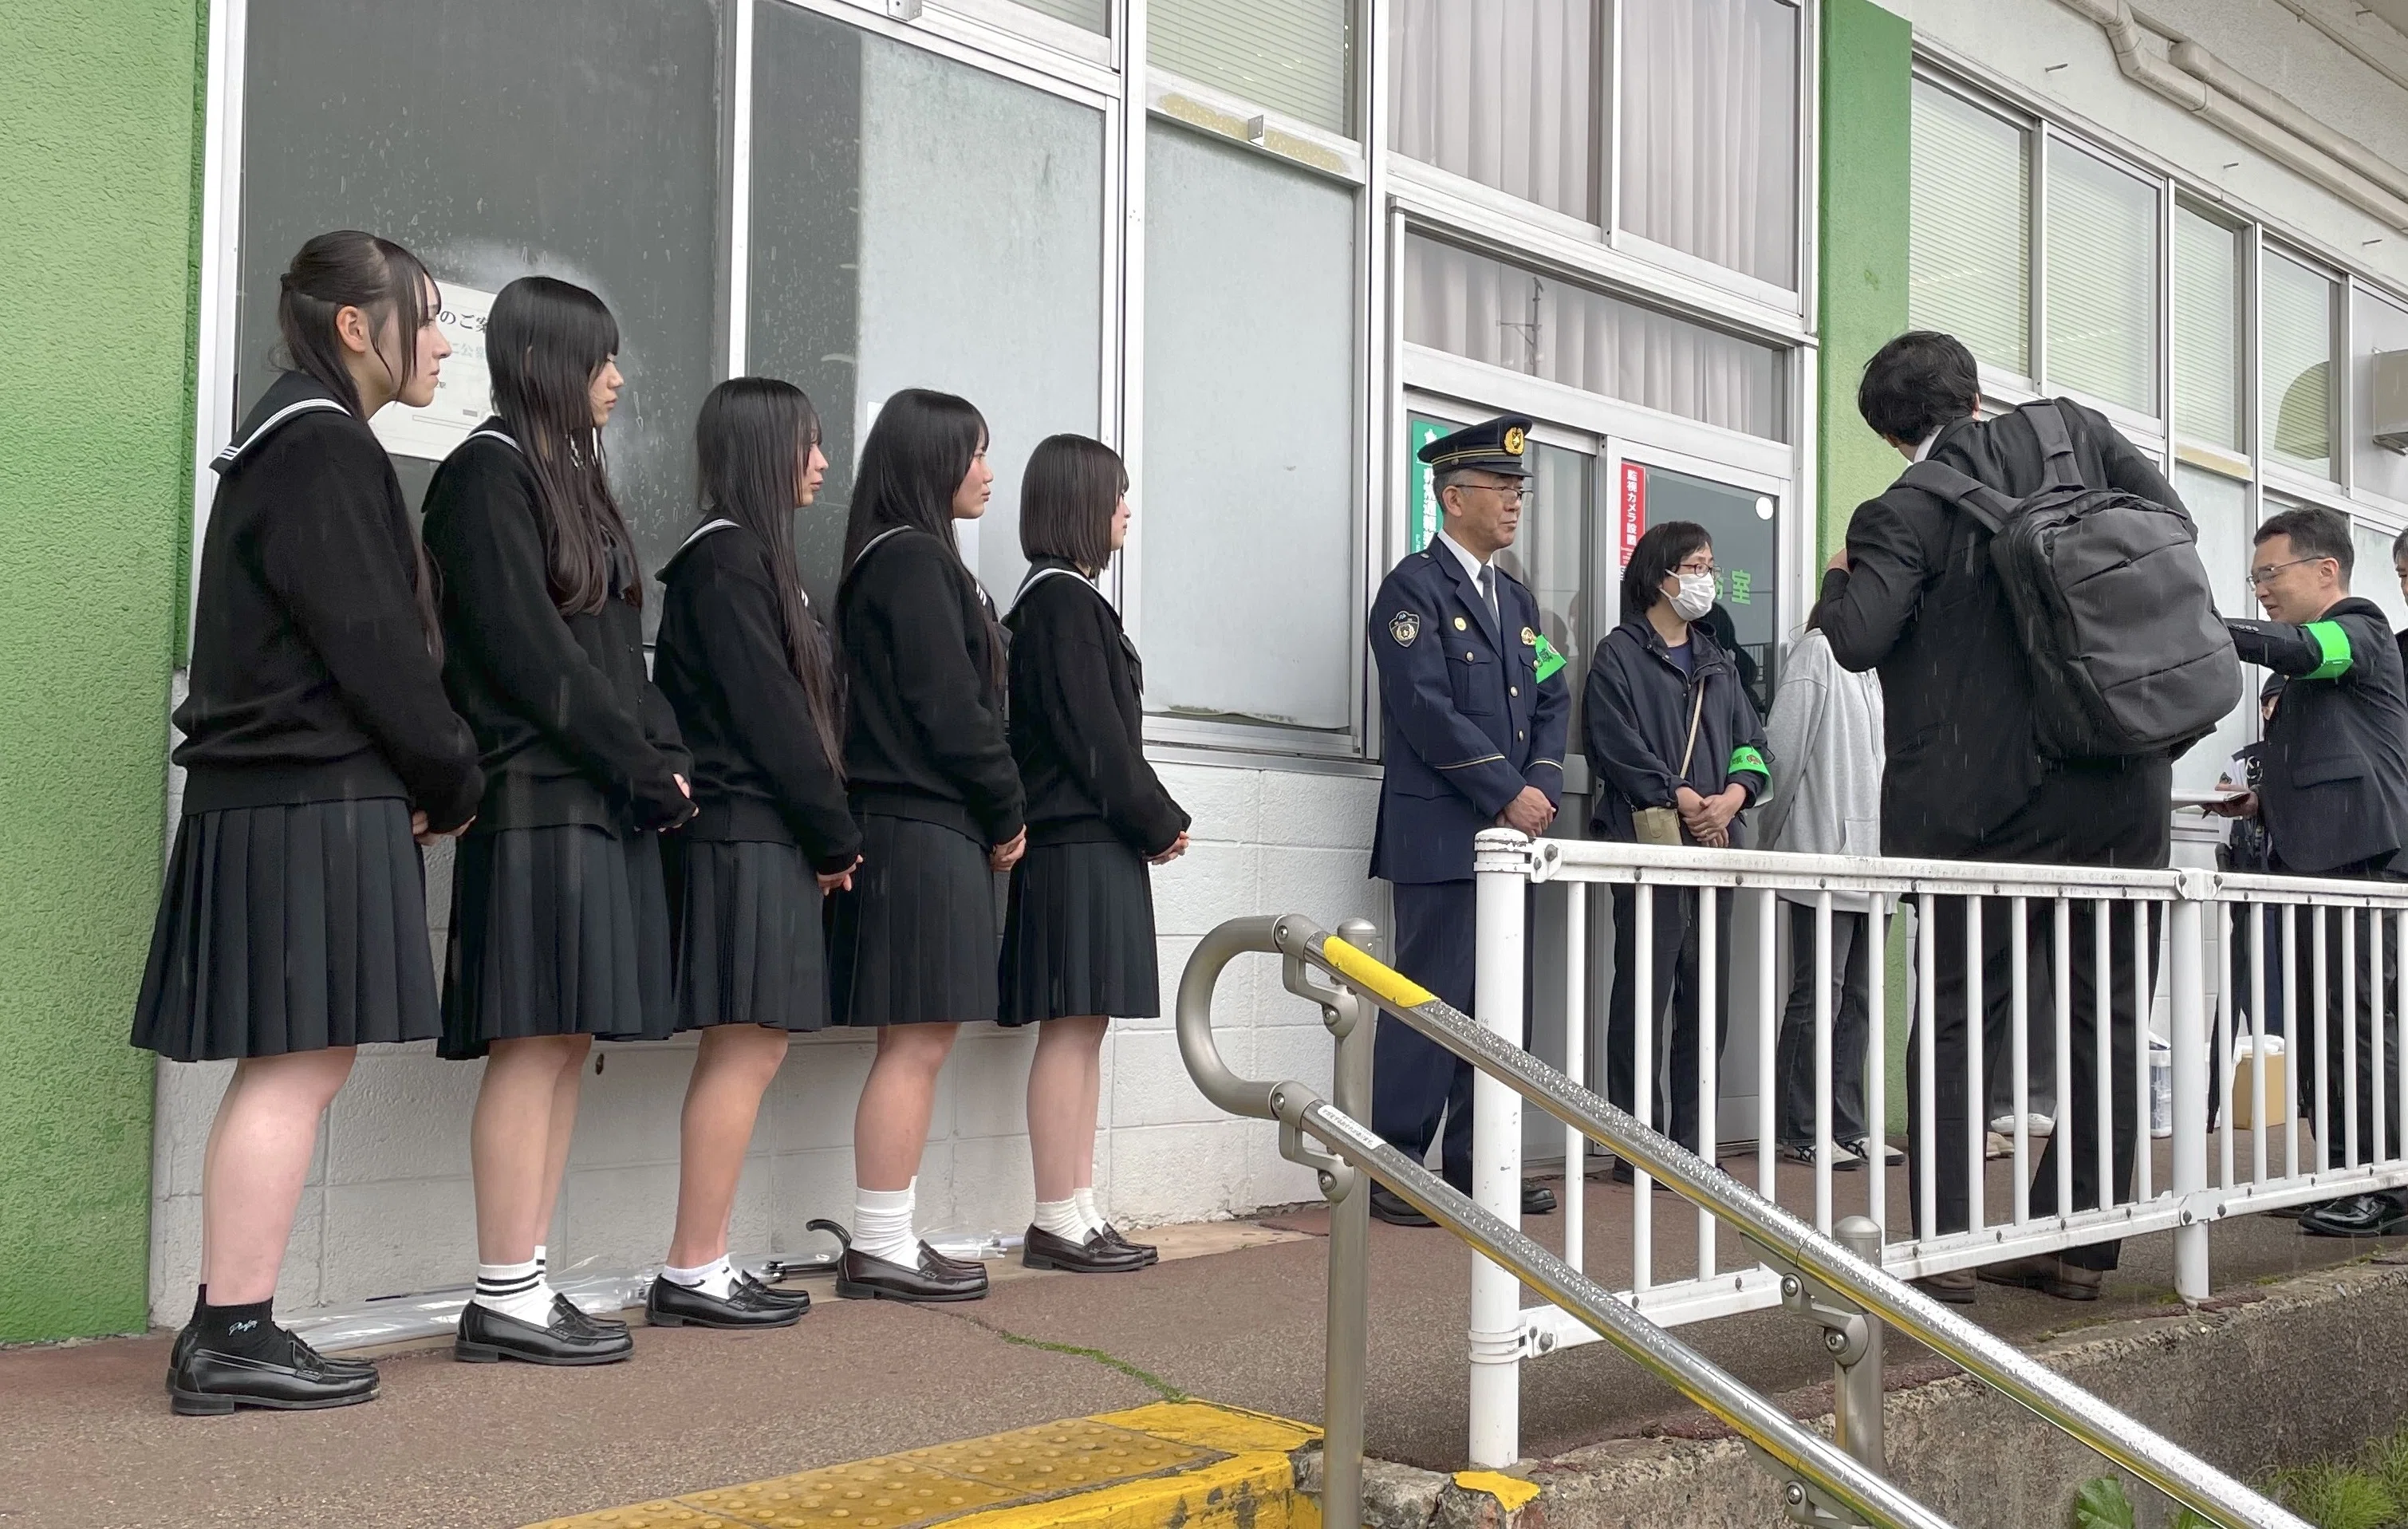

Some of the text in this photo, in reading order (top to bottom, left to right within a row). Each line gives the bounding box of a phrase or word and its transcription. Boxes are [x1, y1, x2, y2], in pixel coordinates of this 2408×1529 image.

[1626, 469, 1638, 546] 監視カメラ設置
